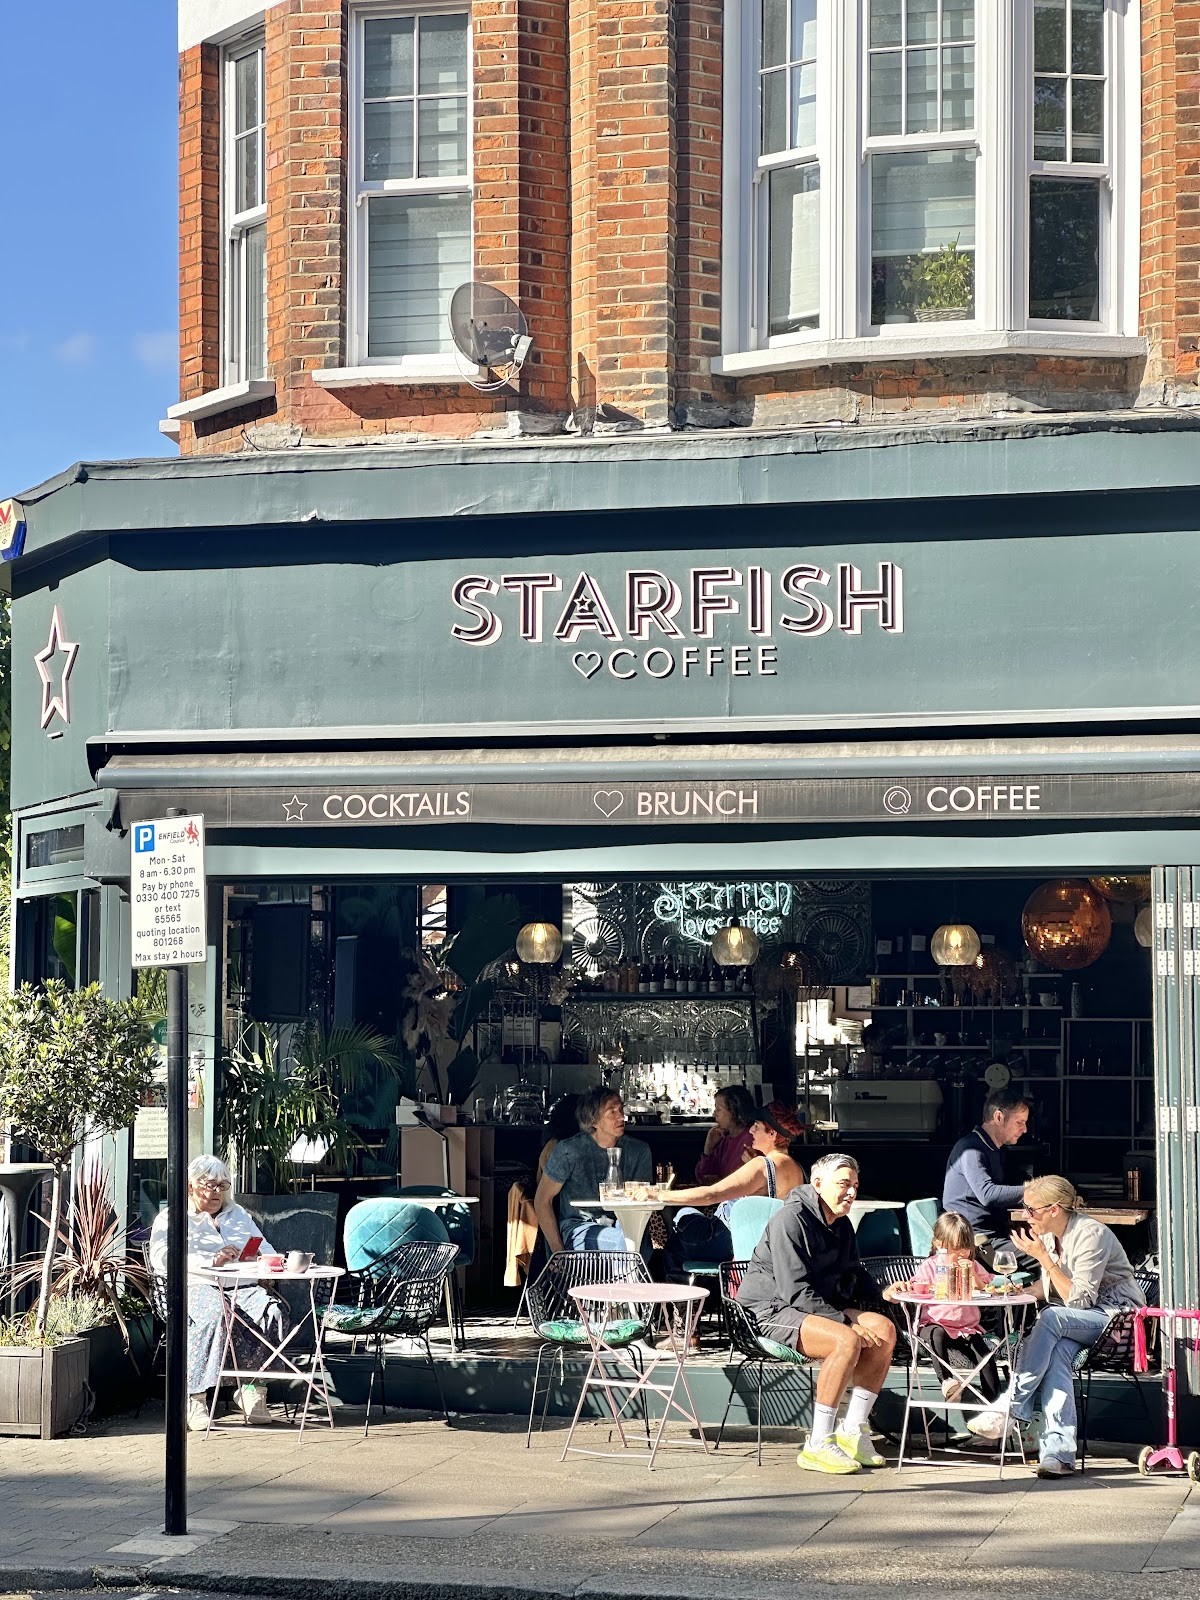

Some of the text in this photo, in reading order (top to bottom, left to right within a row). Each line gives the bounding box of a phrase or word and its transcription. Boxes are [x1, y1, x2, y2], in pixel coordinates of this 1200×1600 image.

[450, 561, 904, 646] STARFISH
[607, 645, 778, 678] COFFEE
[323, 791, 470, 819] COCKTAILS
[637, 789, 758, 816] BRUNCH
[926, 785, 1041, 812] COFFEE
[139, 827, 153, 851] P
[158, 831, 185, 840] ENFIELD
[149, 856, 166, 866] Mon
[171, 854, 186, 863] Sat
[139, 869, 145, 878] 8
[146, 870, 158, 878] am
[163, 866, 182, 876] 6.30
[183, 867, 196, 875] pm
[142, 880, 194, 892] Pay by phone
[136, 889, 200, 903] 0330 400 7275
[165, 903, 181, 912] text
[154, 913, 181, 924] 65565
[136, 925, 200, 939] quoting location
[153, 936, 184, 947] 801268
[135, 950, 203, 962] Max stay 2 hours
